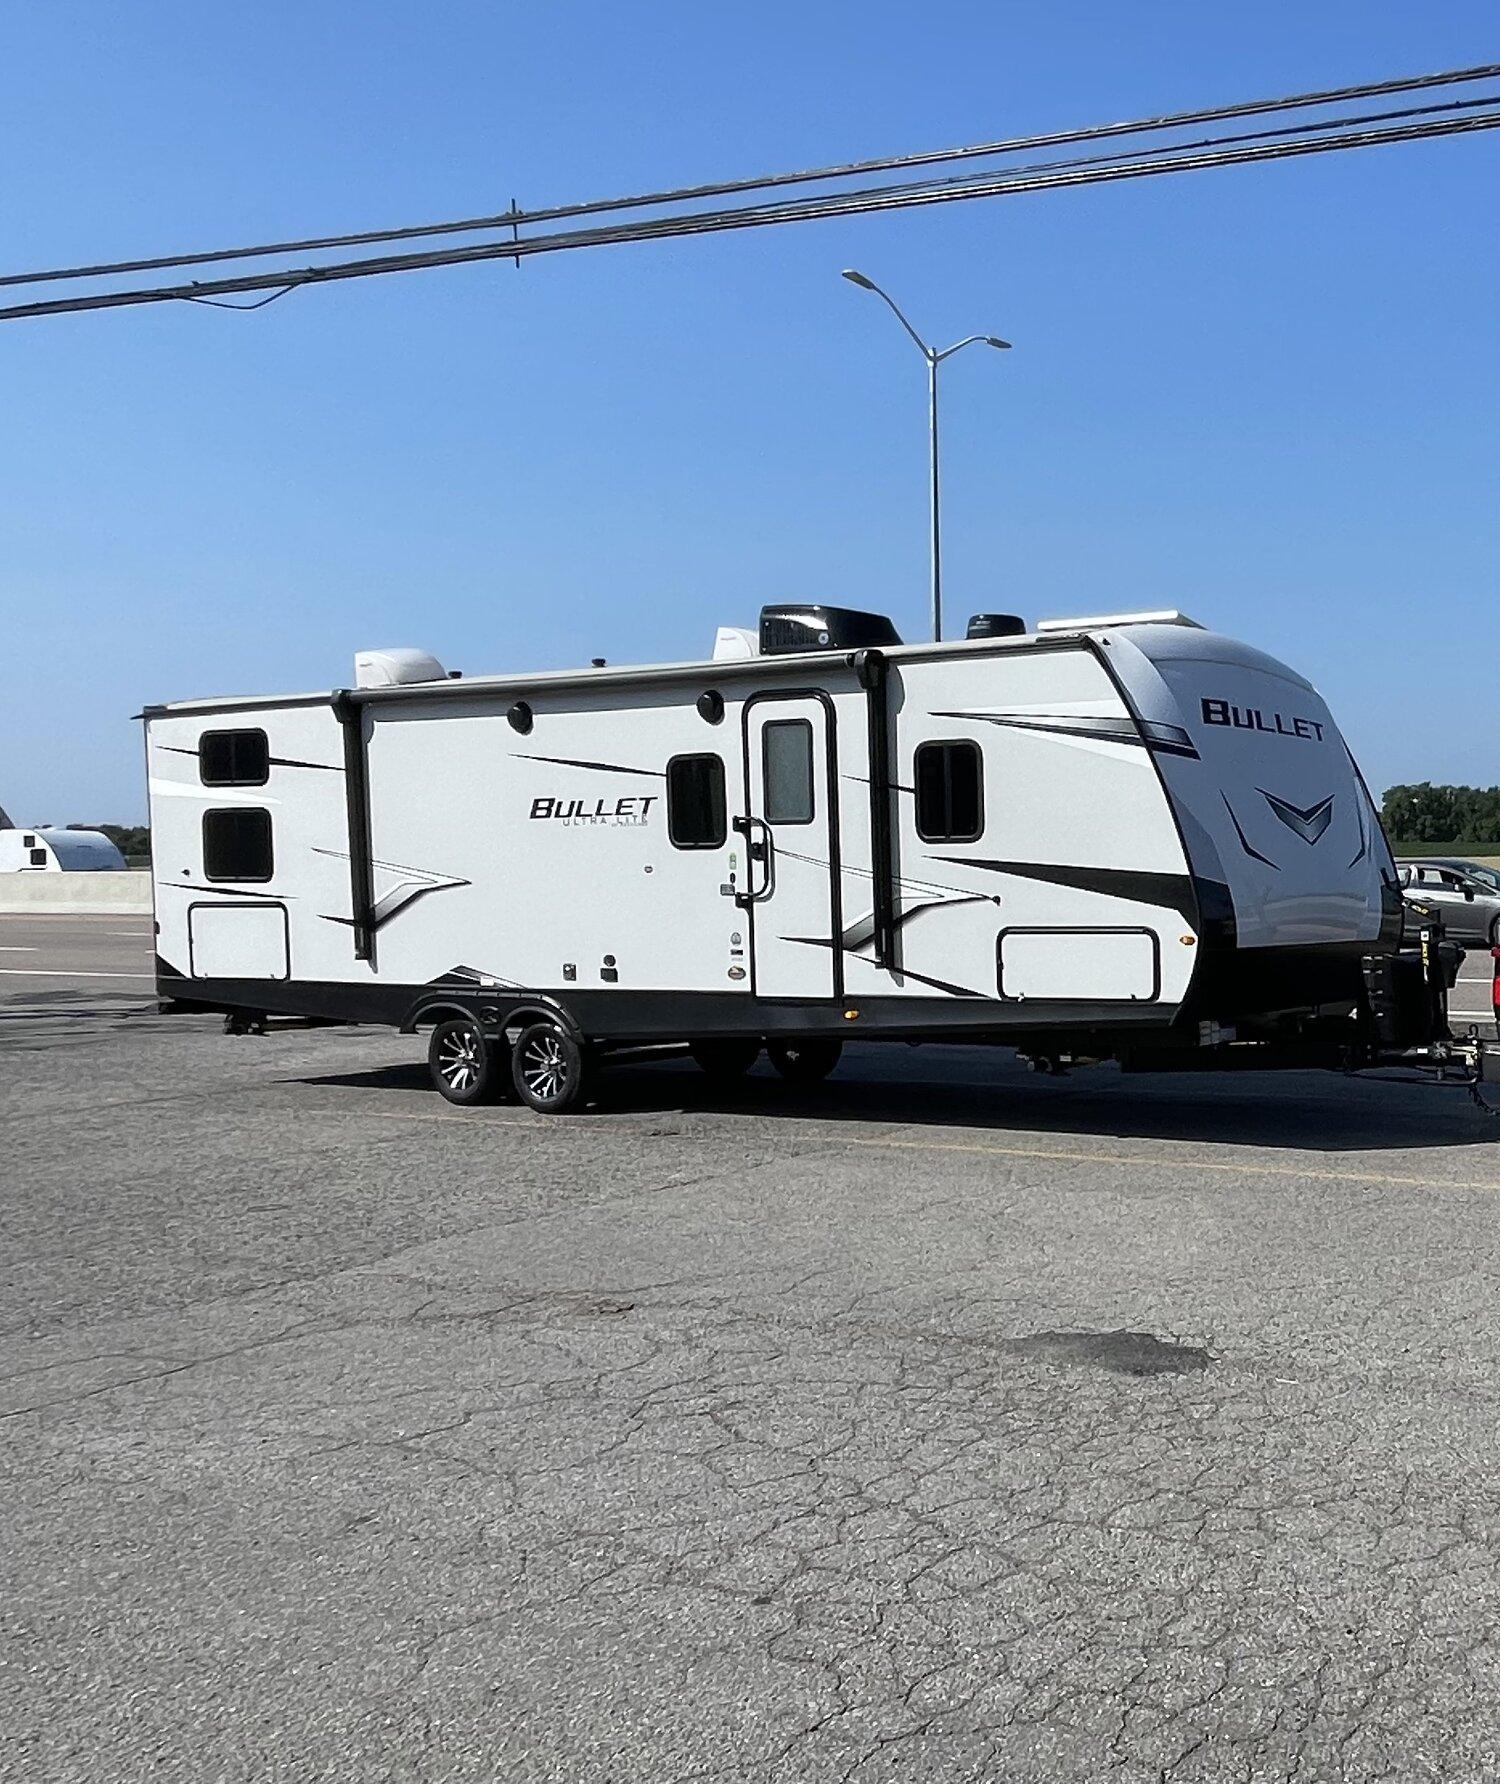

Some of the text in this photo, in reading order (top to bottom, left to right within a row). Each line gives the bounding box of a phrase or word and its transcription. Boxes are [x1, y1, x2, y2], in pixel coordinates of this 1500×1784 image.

[1200, 697, 1324, 741] BULLET
[529, 797, 658, 819] BULLET
[562, 816, 607, 827] ULTRA
[616, 814, 648, 825] LITE
